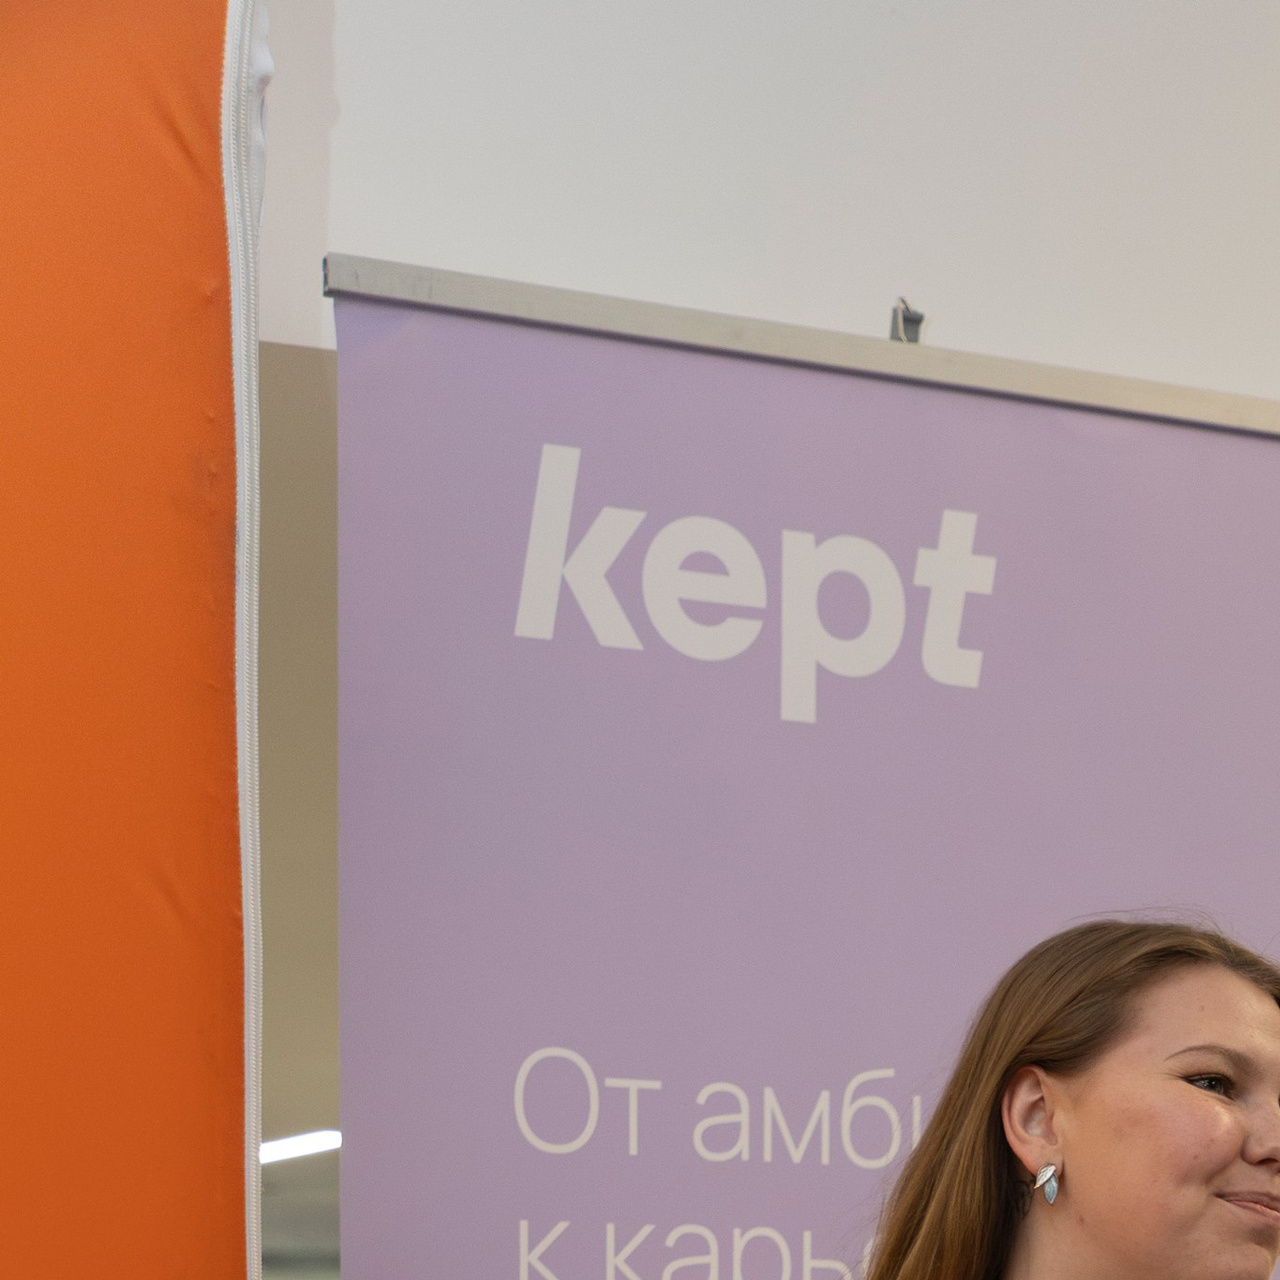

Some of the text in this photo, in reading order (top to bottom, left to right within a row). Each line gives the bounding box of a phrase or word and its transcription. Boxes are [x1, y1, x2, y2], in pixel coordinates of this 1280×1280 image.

[514, 443, 998, 723] kept
[513, 1046, 922, 1170] От амб
